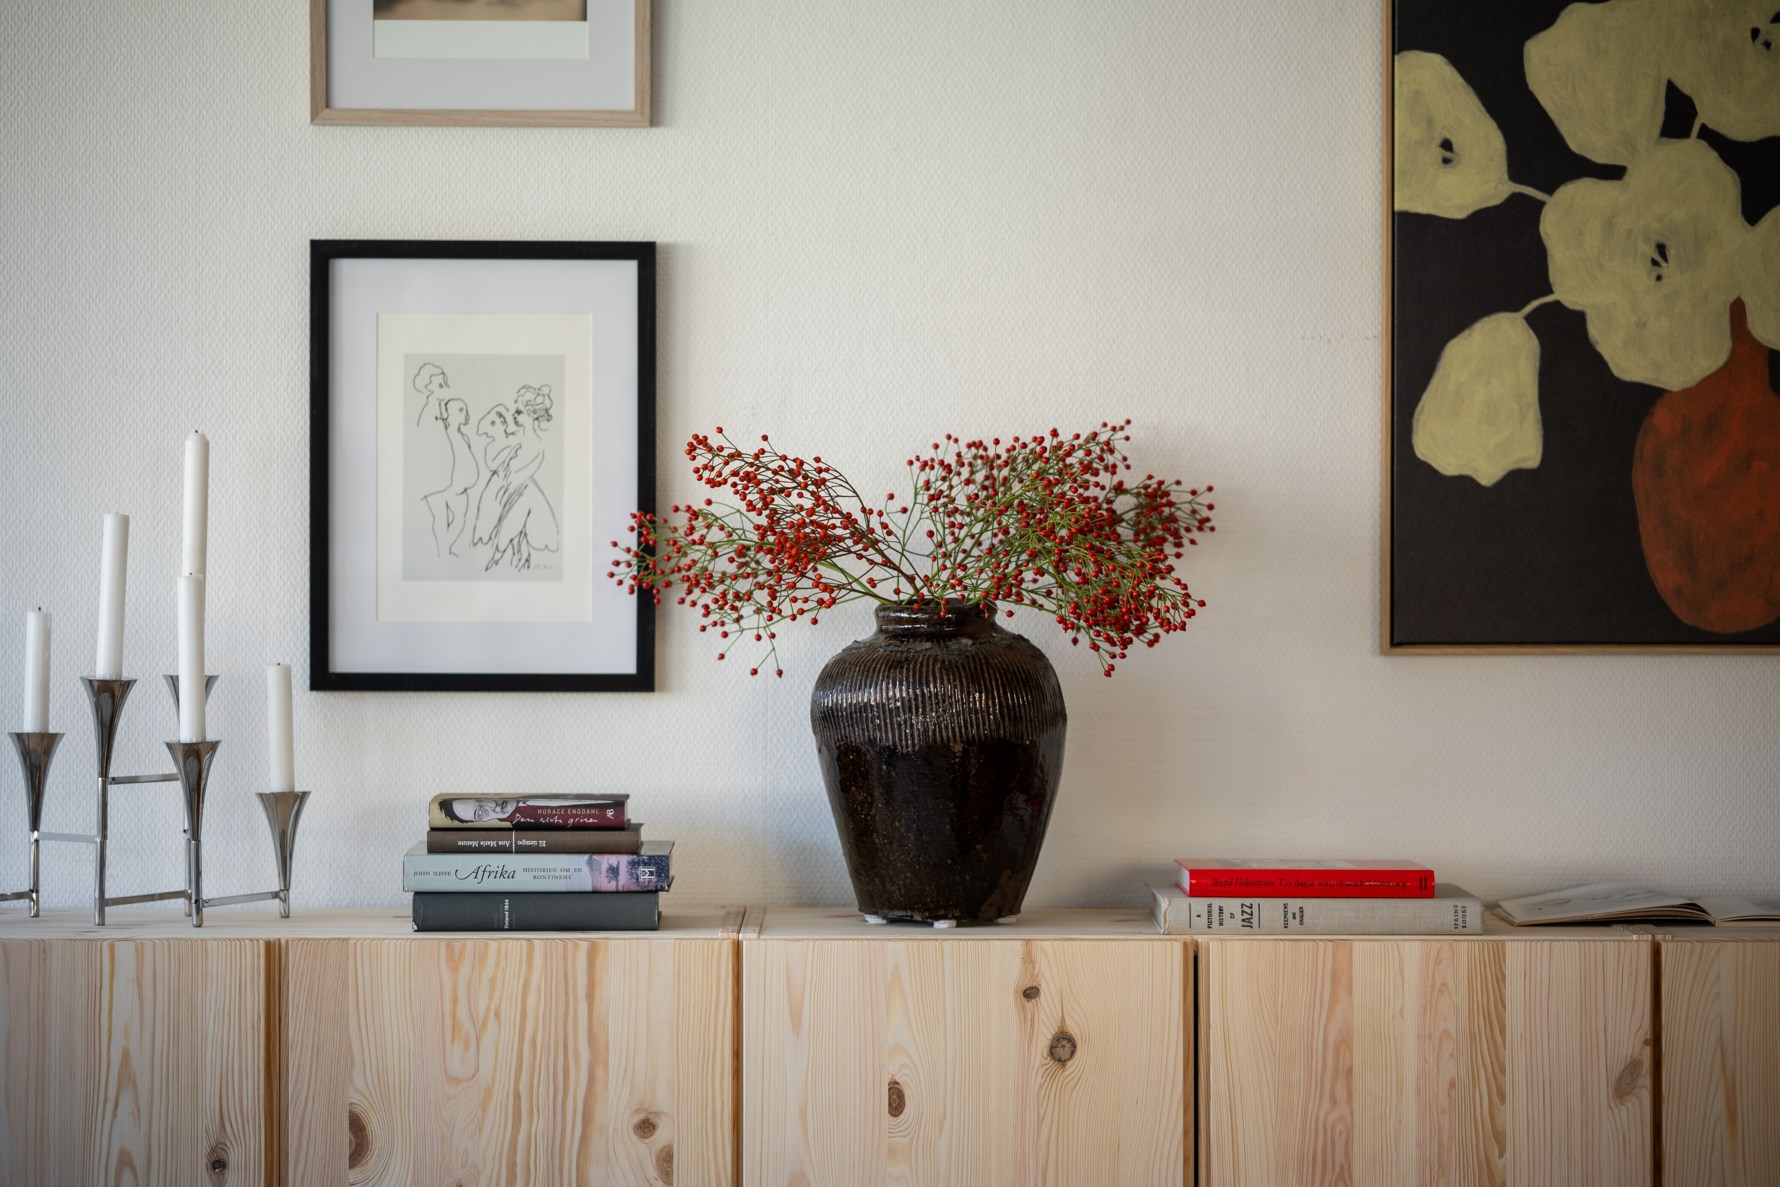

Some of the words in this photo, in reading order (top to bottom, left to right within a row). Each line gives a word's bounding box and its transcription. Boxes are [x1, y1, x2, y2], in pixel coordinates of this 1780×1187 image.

[517, 839, 538, 847] tiempo
[454, 864, 517, 884] Afrika
[1241, 903, 1253, 929] JAZZ
